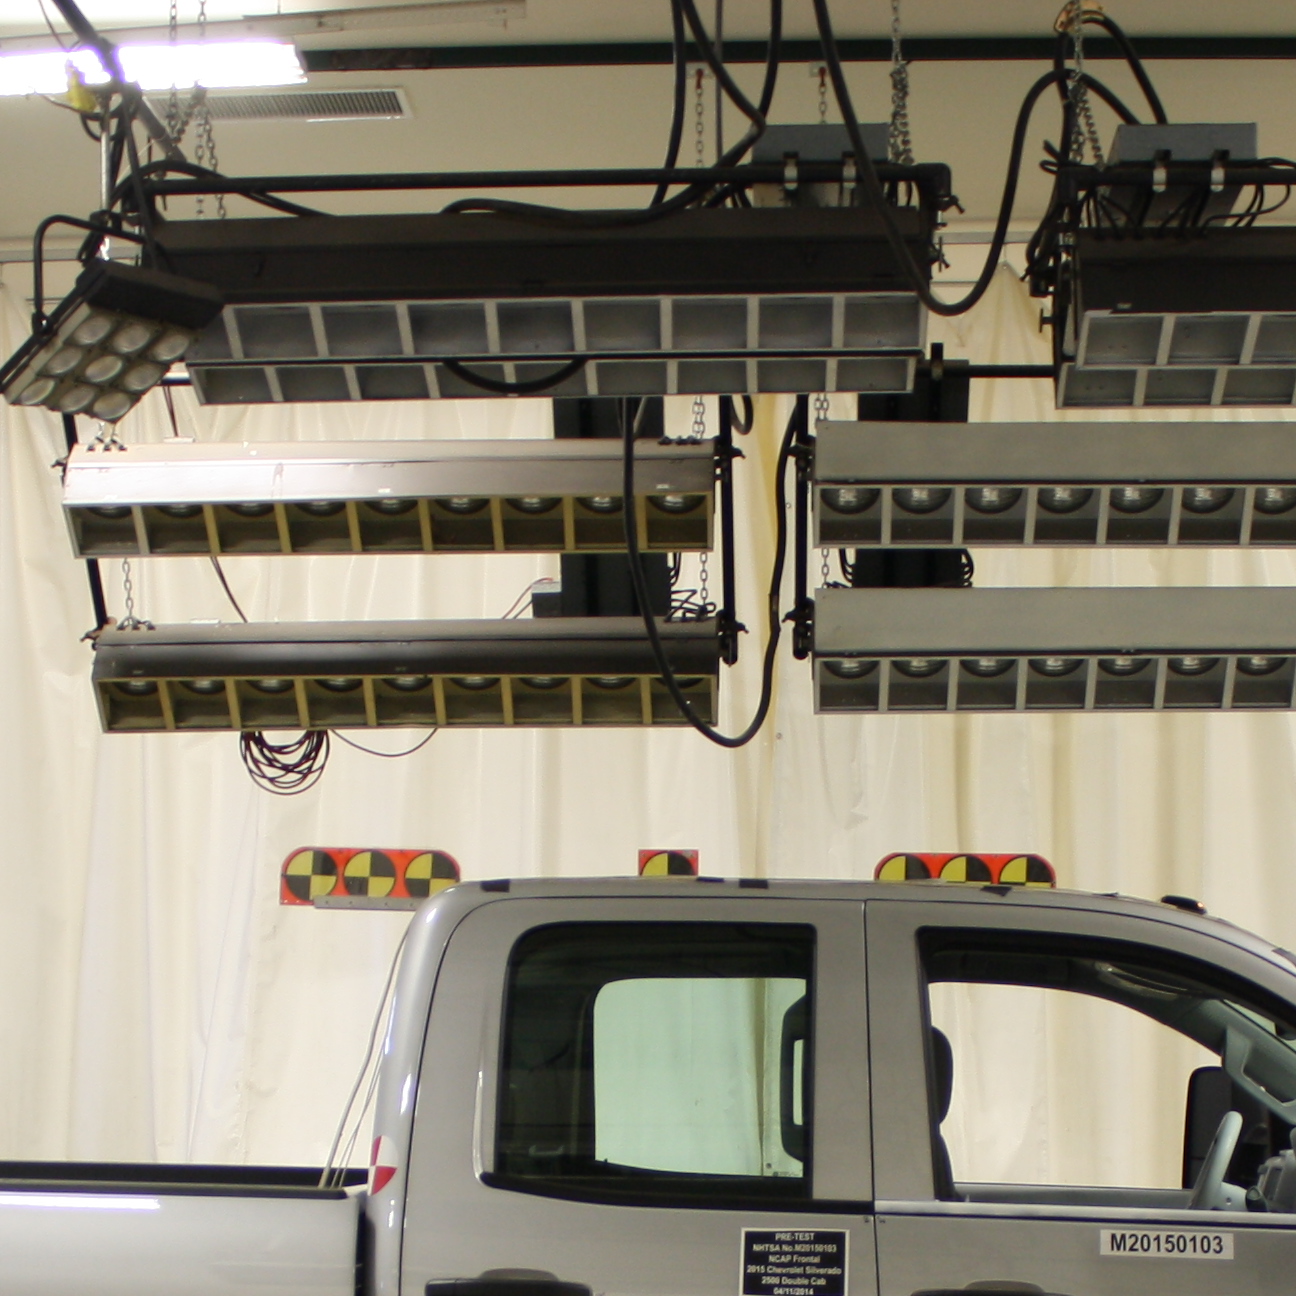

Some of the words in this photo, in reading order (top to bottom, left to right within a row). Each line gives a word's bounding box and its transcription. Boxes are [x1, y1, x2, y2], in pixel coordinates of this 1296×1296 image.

[775, 1232, 815, 1241] PRE-TEST
[752, 1243, 781, 1252] NHTSA
[1110, 1233, 1224, 1254] M20150103
[768, 1254, 792, 1263] NCAP
[792, 1254, 821, 1263] Frontal
[746, 1264, 766, 1274] 2015
[766, 1265, 804, 1274] Chevrolet
[805, 1265, 842, 1275] Silverado
[761, 1276, 781, 1285] 2500
[781, 1276, 810, 1286] Double
[810, 1277, 827, 1286] Cab
[773, 1287, 814, 1296] 04/11/2014
